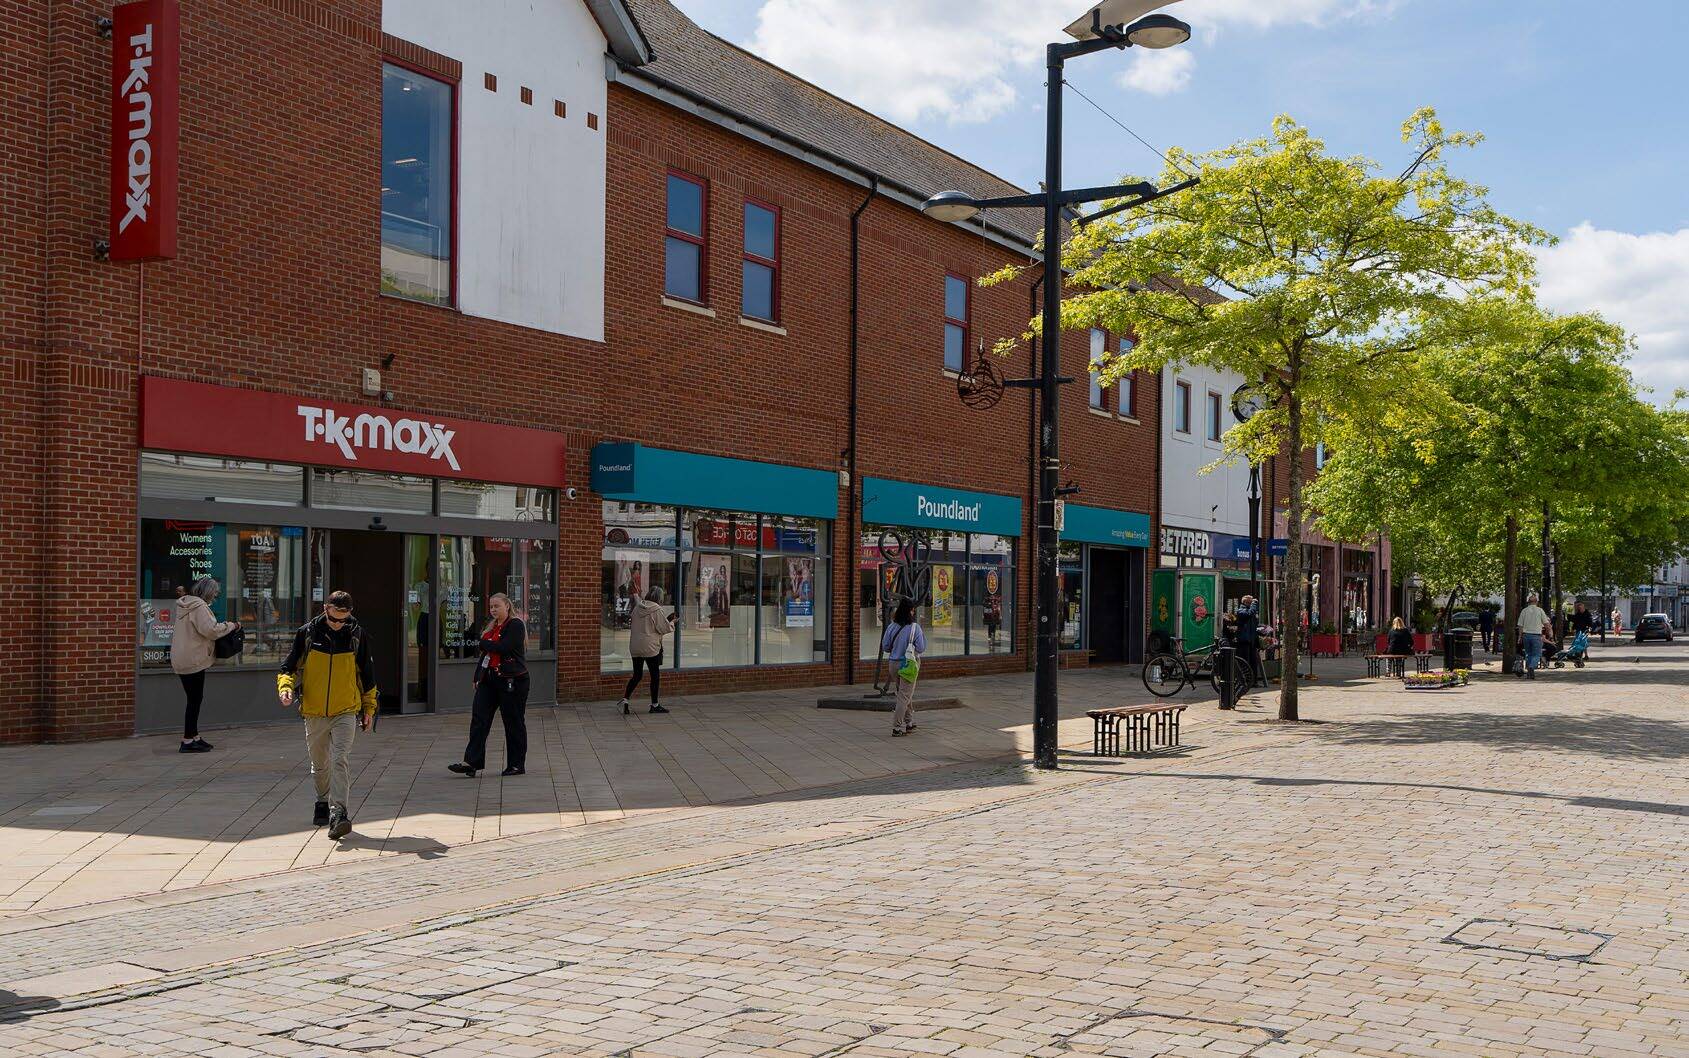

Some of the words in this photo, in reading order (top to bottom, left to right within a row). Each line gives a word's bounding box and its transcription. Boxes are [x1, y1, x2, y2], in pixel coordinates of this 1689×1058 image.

[599, 464, 632, 472] Poundland
[918, 495, 982, 522] Poundland
[179, 532, 212, 543] Womens
[1160, 528, 1209, 556] BETFRED
[170, 545, 212, 556] Accessories
[189, 558, 212, 568] Shoes
[192, 570, 212, 581] Mens
[615, 598, 630, 613] £7
[143, 651, 164, 661] SHOP
